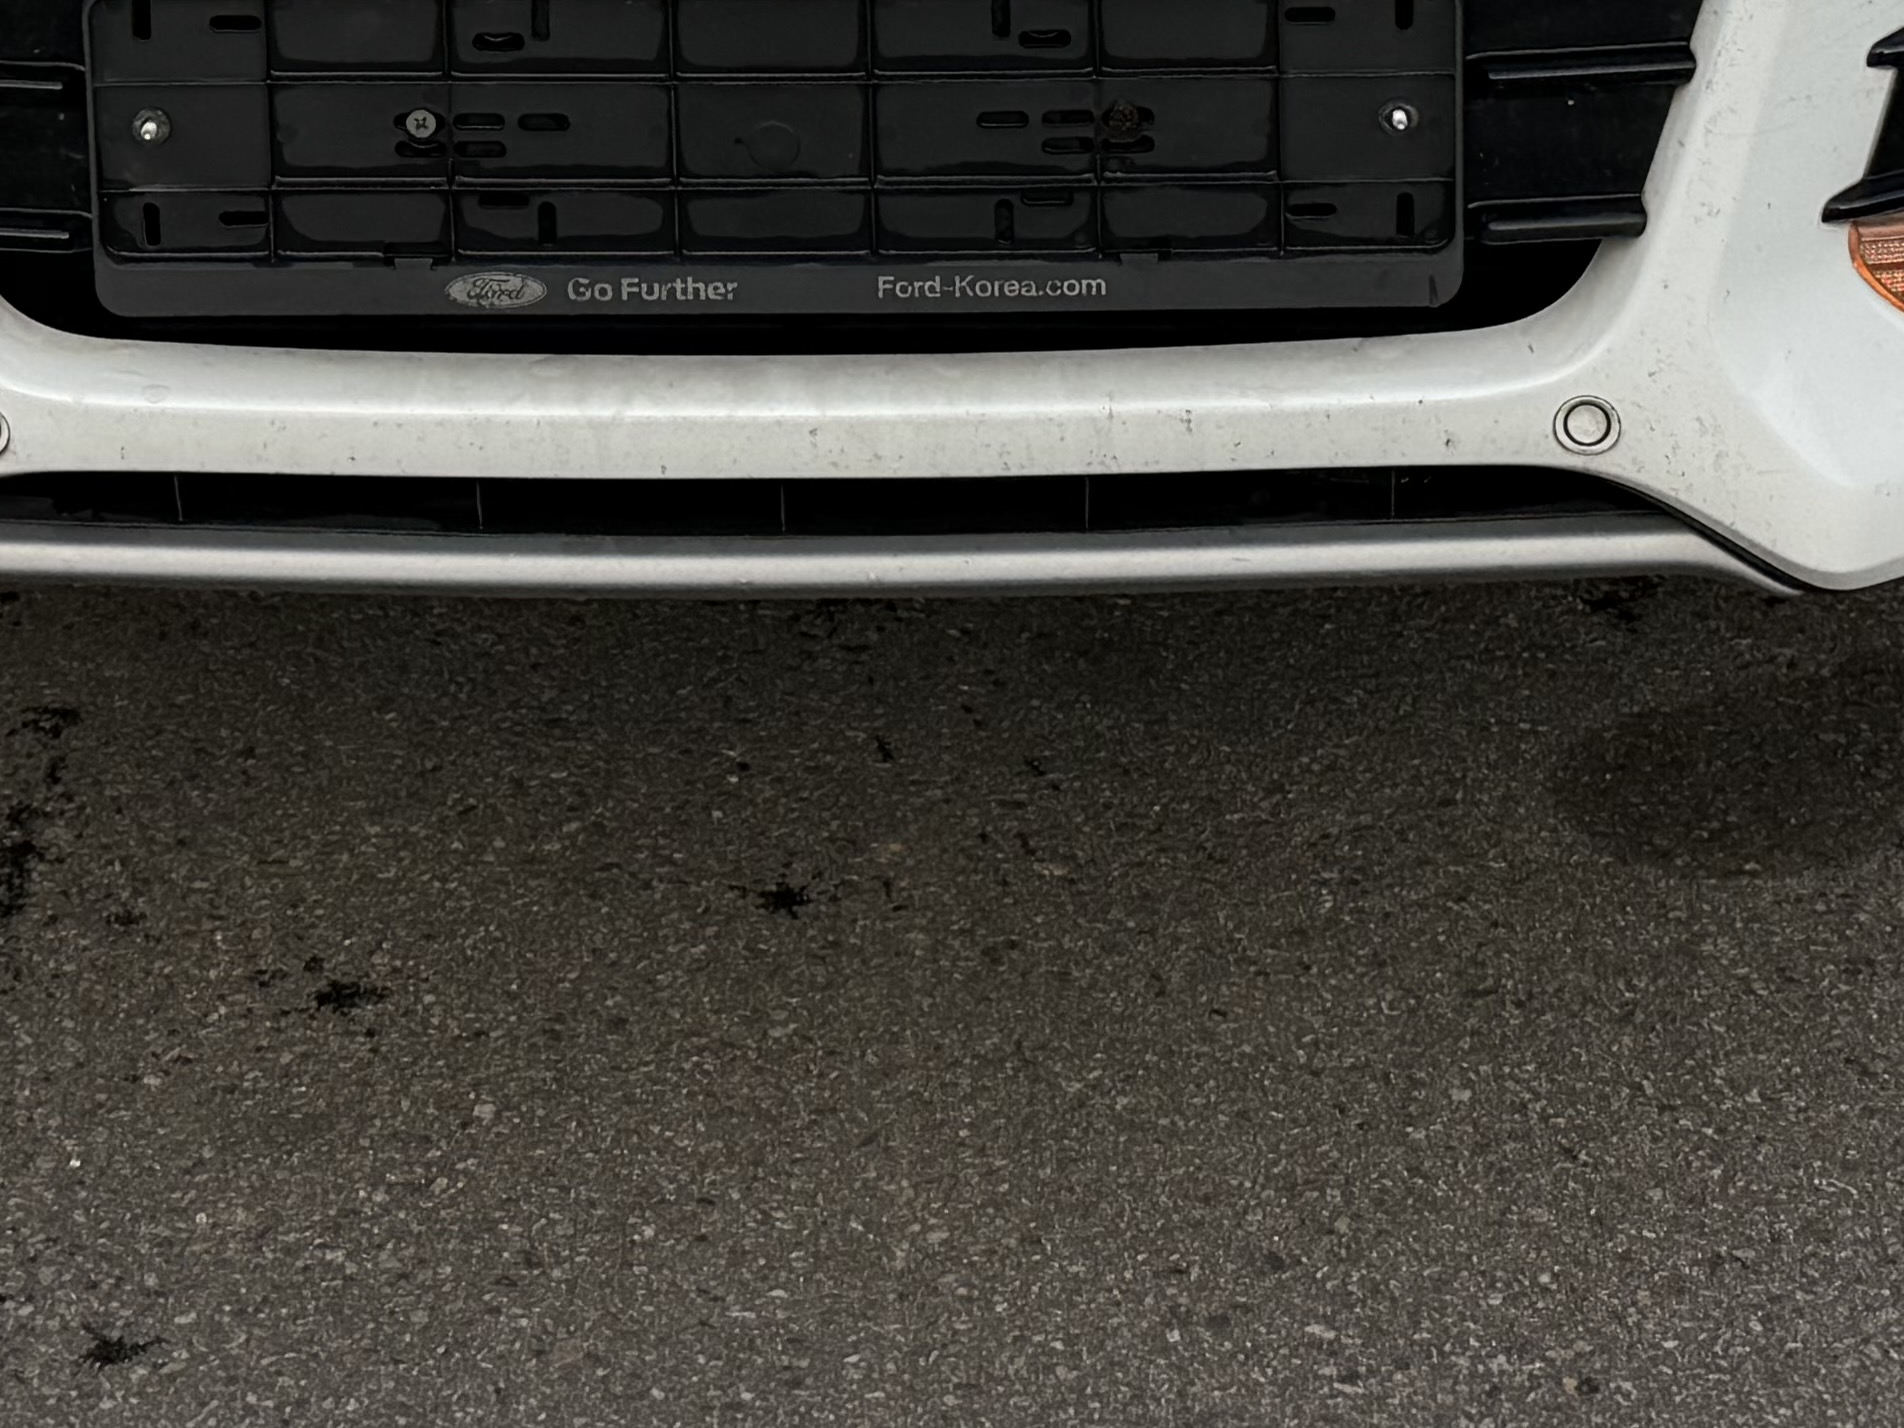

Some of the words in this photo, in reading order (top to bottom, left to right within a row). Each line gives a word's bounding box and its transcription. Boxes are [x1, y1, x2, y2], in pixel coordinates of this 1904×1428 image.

[466, 276, 525, 301] Ford
[567, 276, 613, 302] Go
[621, 276, 739, 301] Further
[877, 274, 1107, 299] Ford-Korea.com
